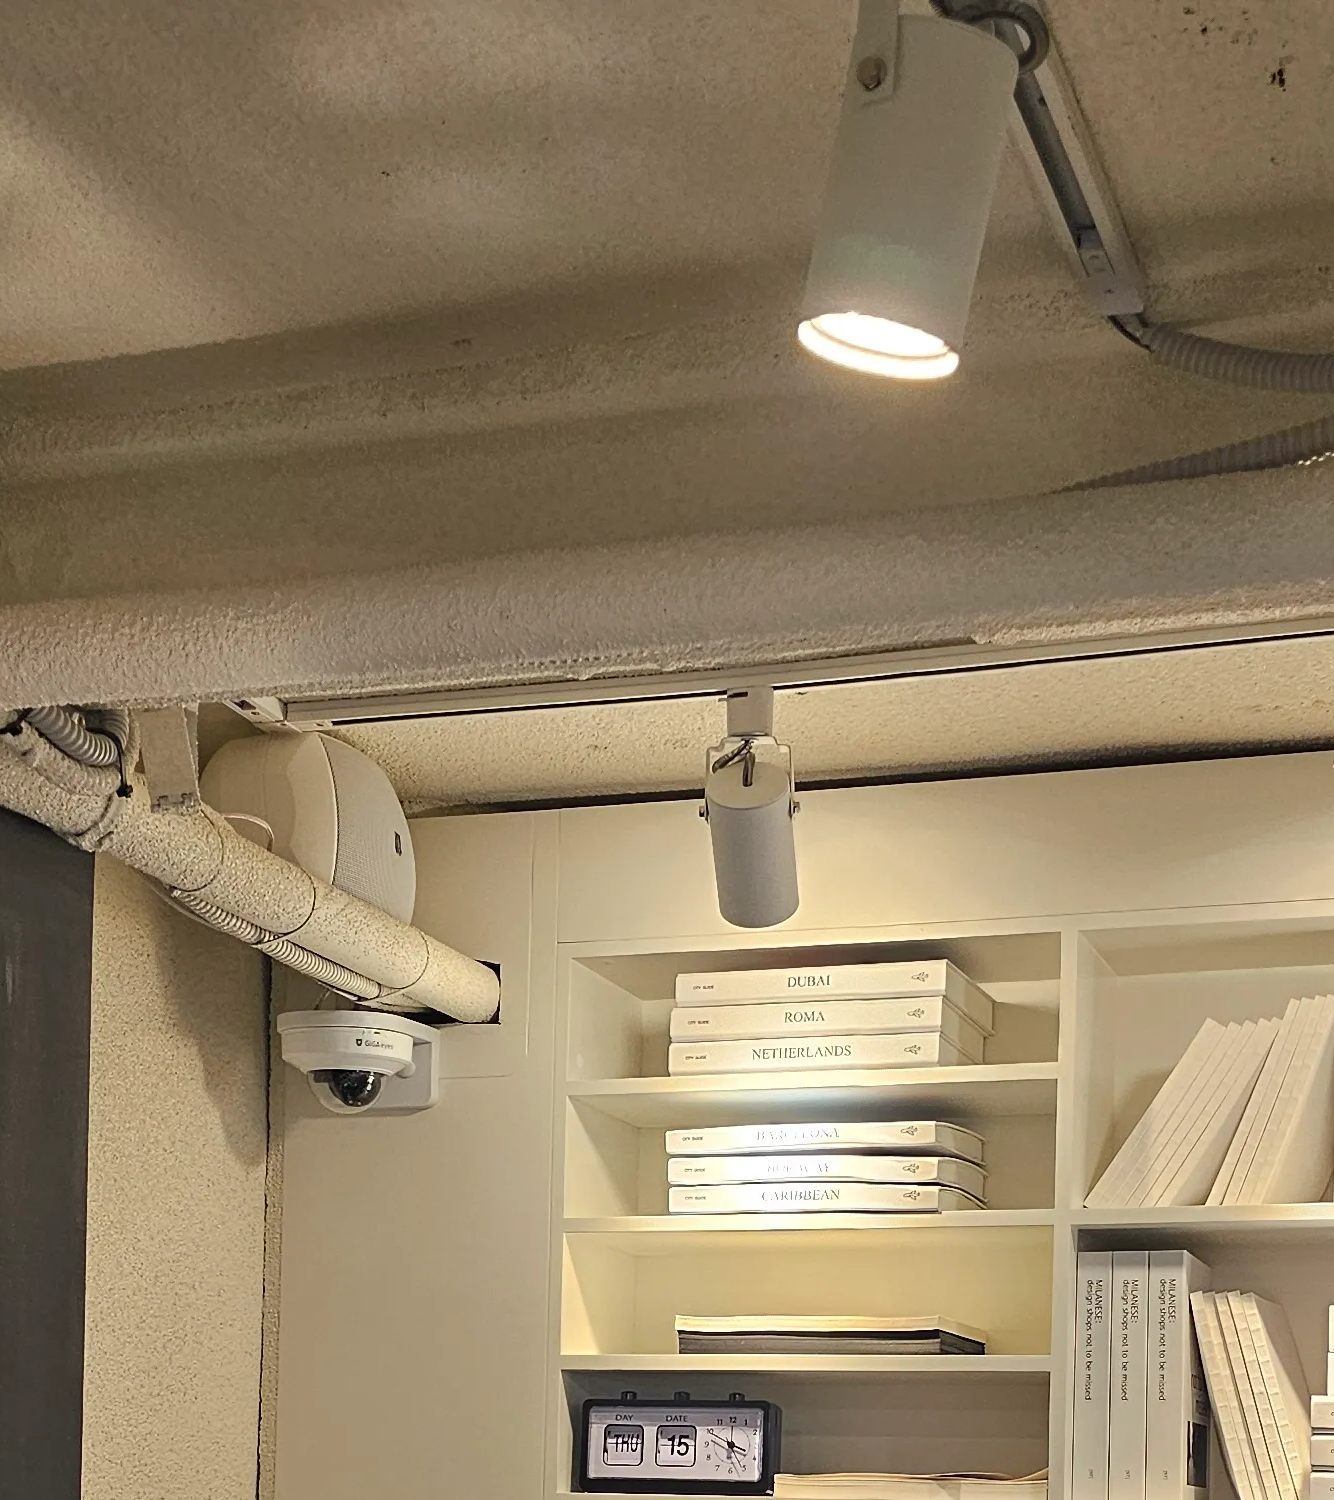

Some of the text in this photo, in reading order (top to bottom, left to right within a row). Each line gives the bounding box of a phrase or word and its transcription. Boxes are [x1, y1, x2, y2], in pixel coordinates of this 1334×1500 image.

[788, 975, 830, 987] DUBAI
[785, 1011, 824, 1023] ROMA
[753, 1045, 851, 1060] NETHERLANDS
[667, 1435, 689, 1456] 15
